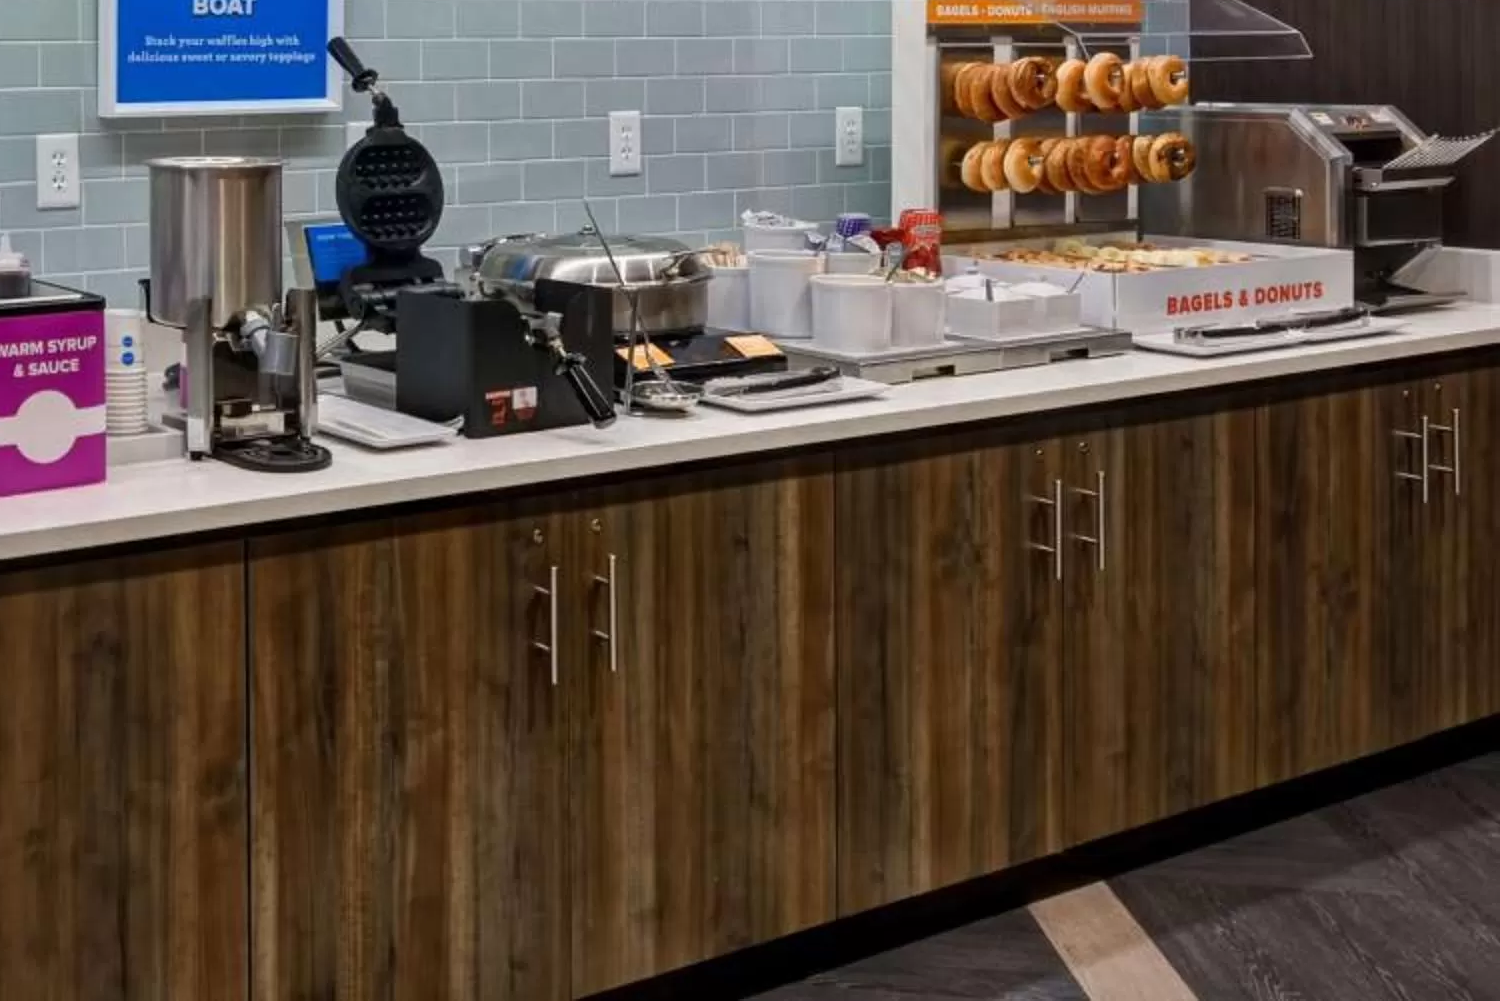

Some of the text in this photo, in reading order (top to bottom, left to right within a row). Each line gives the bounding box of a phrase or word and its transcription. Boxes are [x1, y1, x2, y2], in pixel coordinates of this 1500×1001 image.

[935, 4, 979, 16] BAGELS
[987, 4, 1033, 16] DONUTS
[144, 35, 301, 49] Stack your waffles high with
[127, 51, 316, 65] delicious sweet or savory toppings
[1166, 281, 1324, 316] BAGELS & DONUTS
[47, 335, 98, 354] SYRUP
[12, 358, 81, 378] & SAUCE
